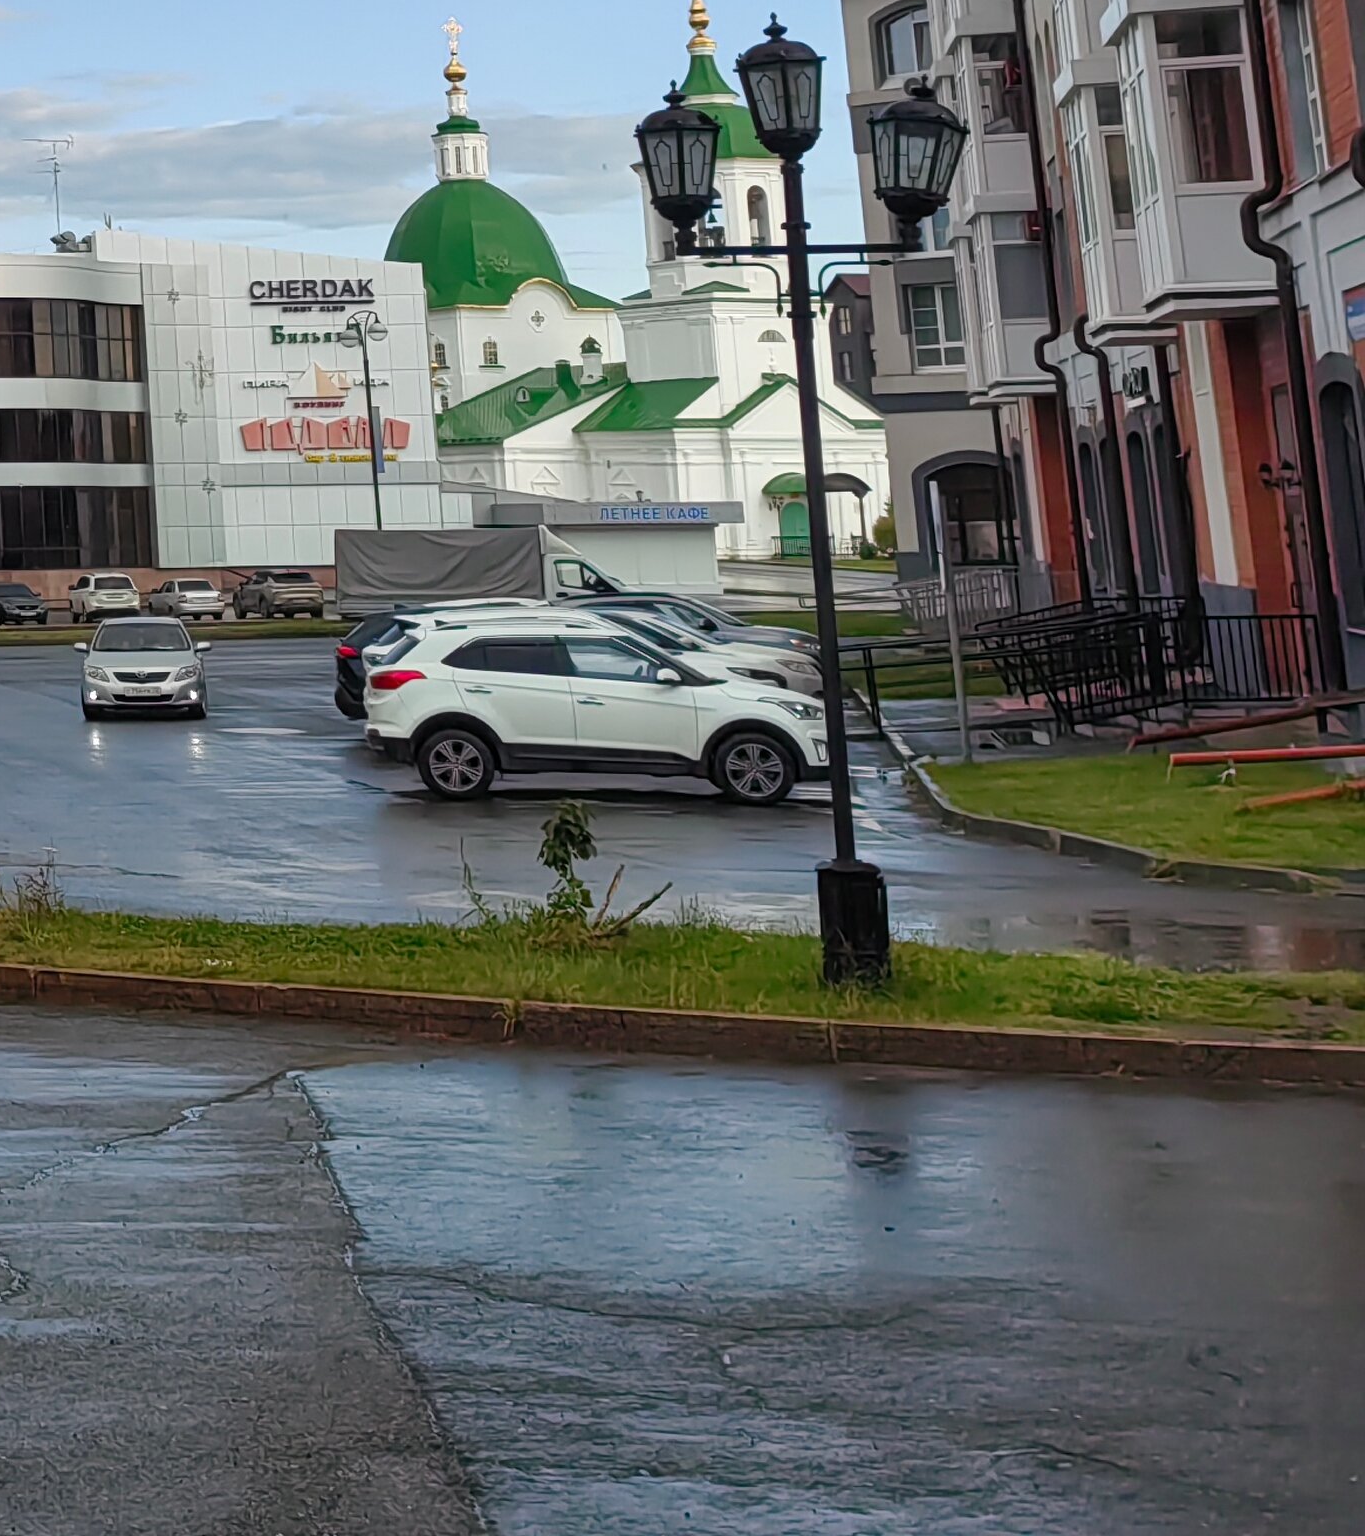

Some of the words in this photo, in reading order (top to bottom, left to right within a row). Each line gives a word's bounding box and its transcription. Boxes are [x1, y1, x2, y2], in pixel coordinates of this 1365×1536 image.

[249, 278, 374, 300] CHERDAK
[600, 507, 662, 521] ЛЕТНЕЕ
[666, 506, 710, 520] КАФЕ
